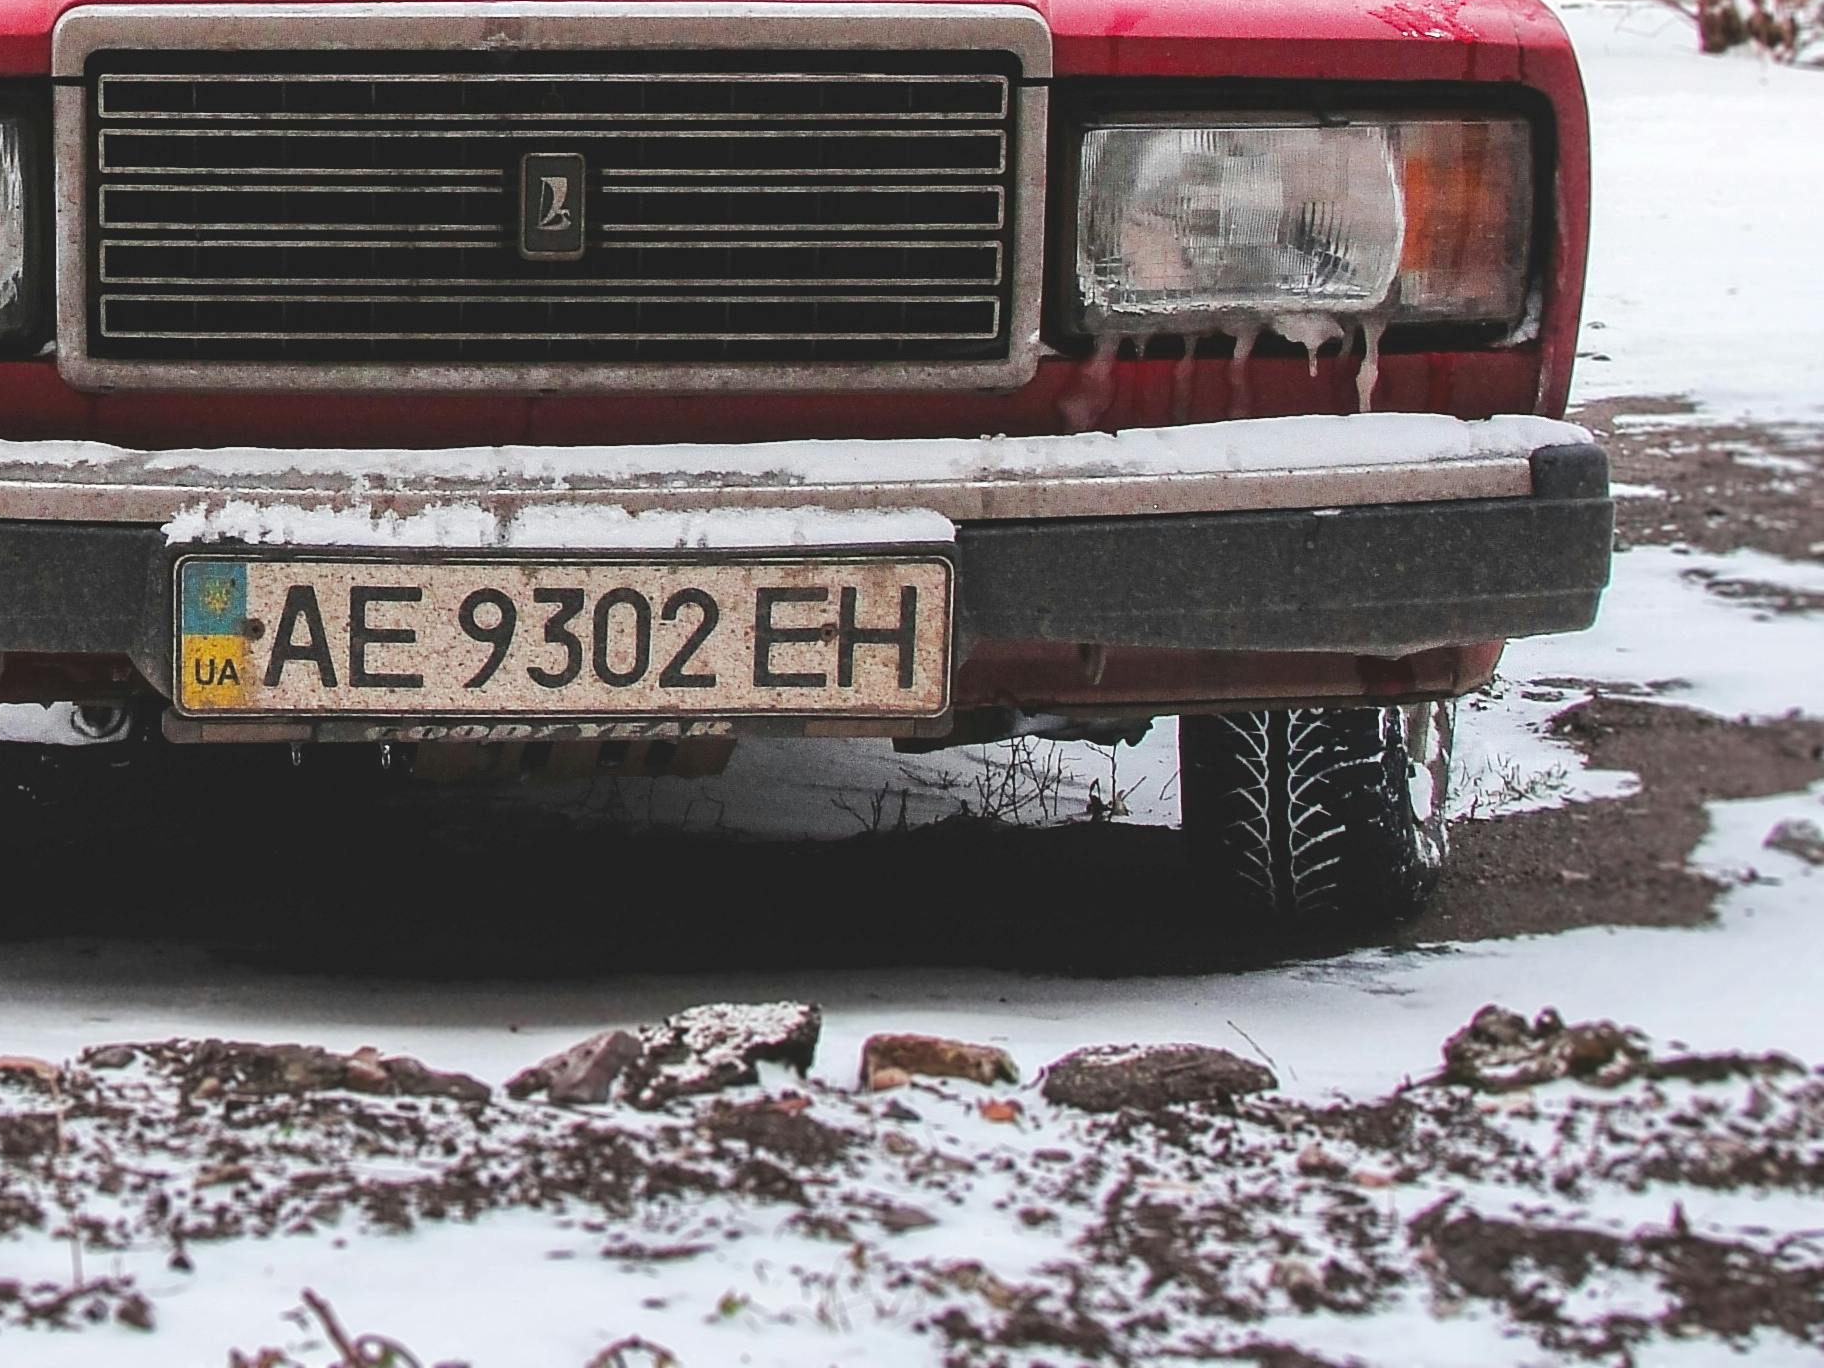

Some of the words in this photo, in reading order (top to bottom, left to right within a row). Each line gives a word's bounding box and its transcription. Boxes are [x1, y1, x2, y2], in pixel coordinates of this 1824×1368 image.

[263, 585, 424, 689] AE
[458, 587, 720, 689] 9302
[753, 585, 918, 689] EH
[194, 658, 241, 686] UA
